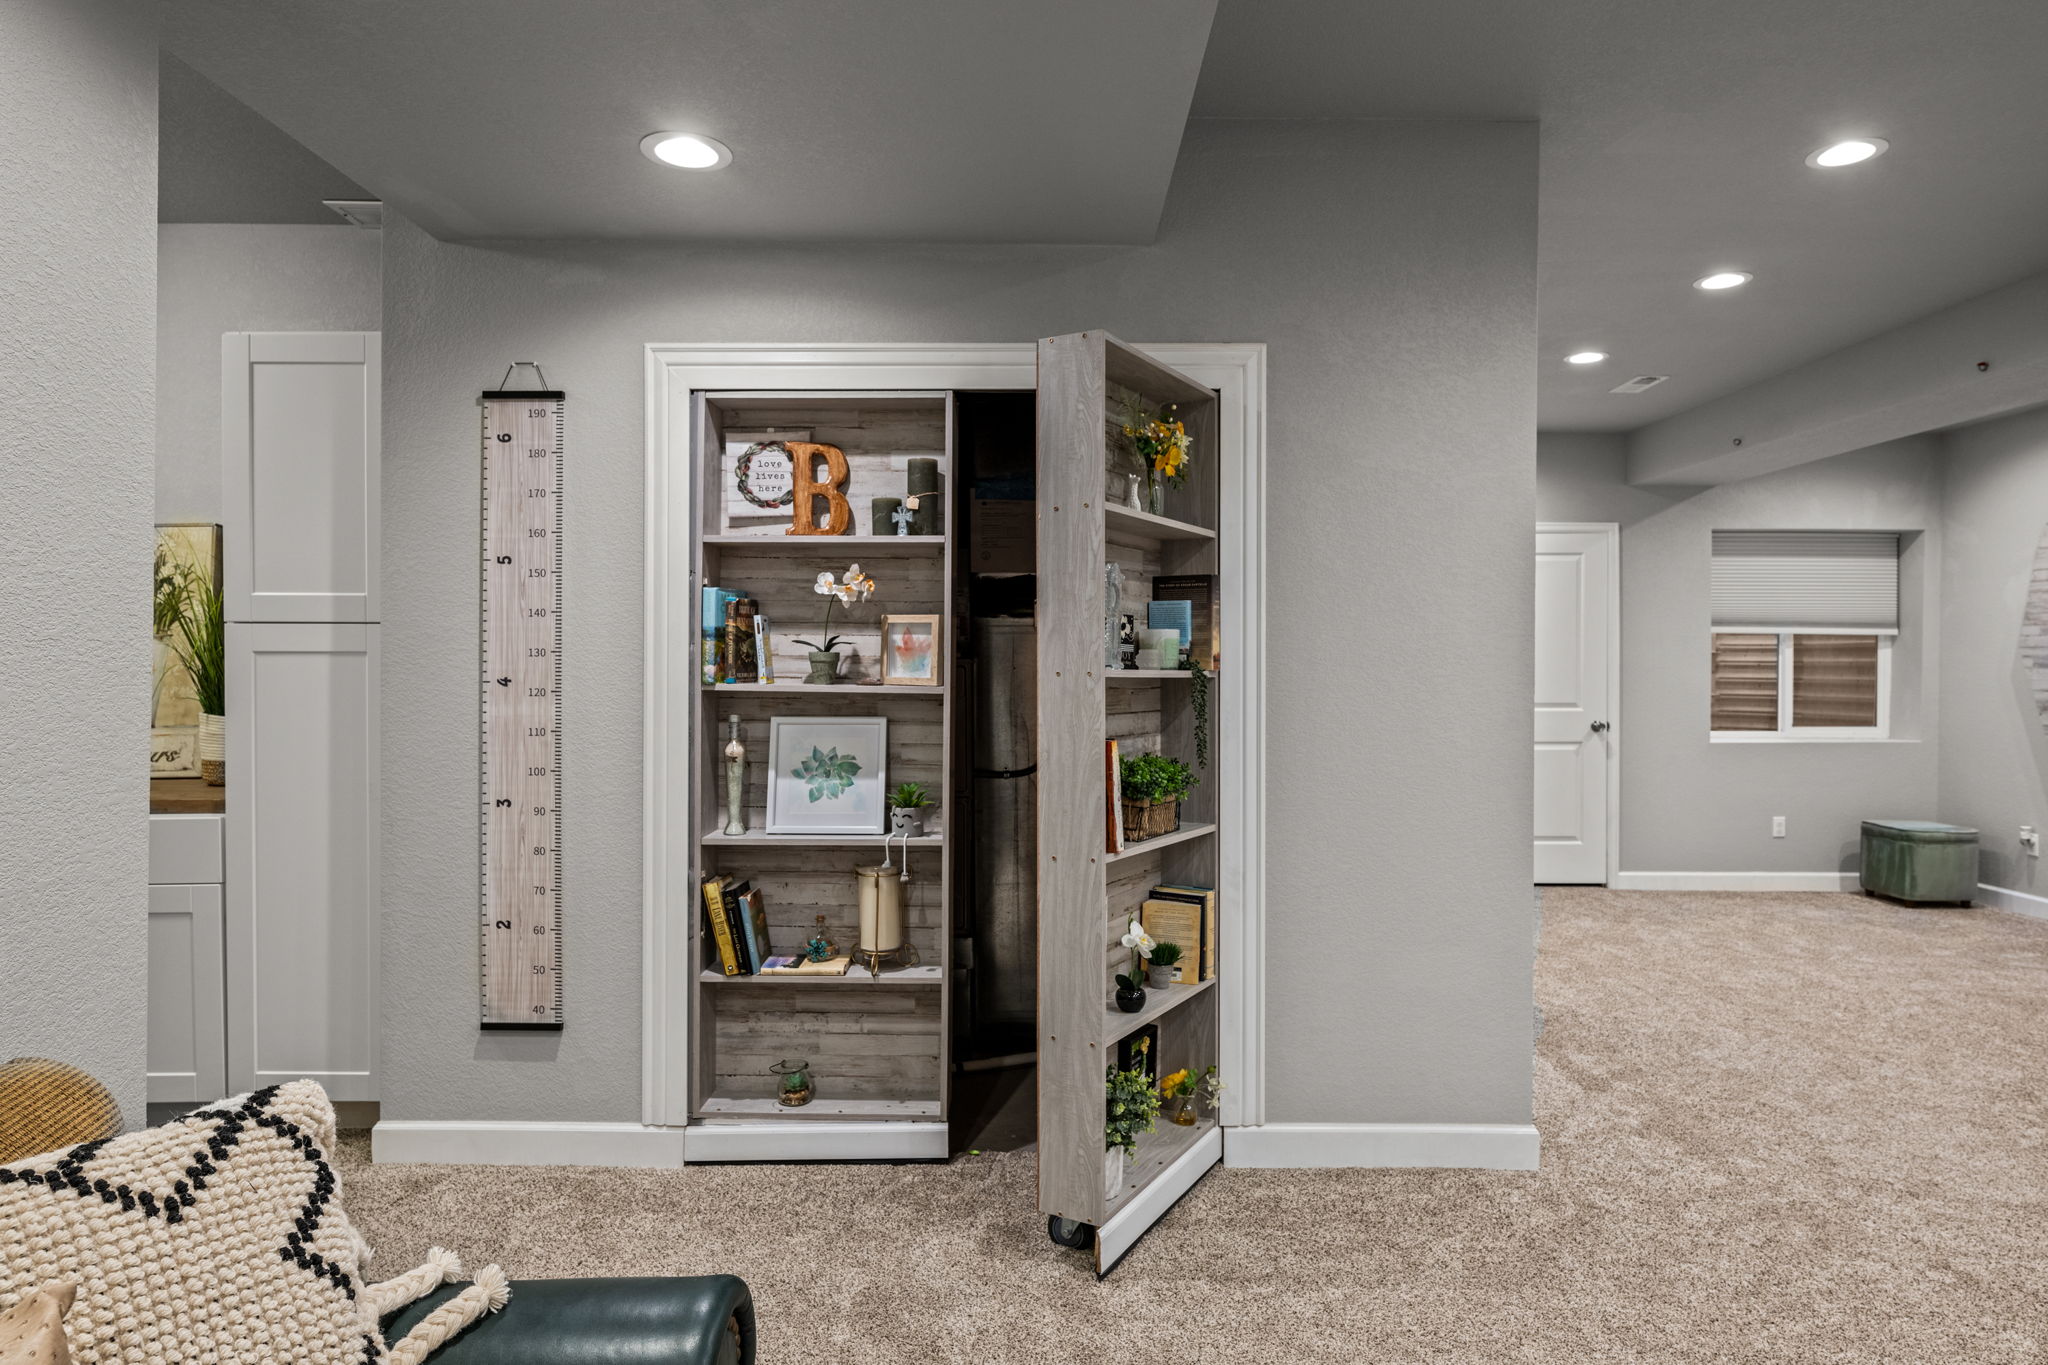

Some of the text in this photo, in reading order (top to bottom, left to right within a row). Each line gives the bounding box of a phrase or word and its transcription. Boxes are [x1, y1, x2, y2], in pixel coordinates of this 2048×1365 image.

[528, 408, 546, 418] 190
[496, 434, 512, 442] 6
[528, 448, 546, 458] 180
[758, 460, 782, 468] love
[528, 488, 546, 498] 170
[784, 441, 849, 535] B
[528, 528, 546, 538] 160
[496, 556, 512, 564] 5
[528, 568, 546, 578] 150
[528, 608, 546, 618] 140
[528, 648, 546, 658] 130
[496, 676, 512, 688] 4
[530, 688, 546, 696] 120
[528, 728, 546, 736] 110
[528, 768, 546, 776] 100
[496, 798, 512, 808] 3
[534, 806, 546, 816] 90
[534, 846, 546, 856] 80
[534, 886, 546, 896] 70
[496, 920, 512, 930] 2
[534, 926, 546, 936] 60
[534, 966, 546, 974] 50
[532, 1006, 544, 1014] 40
